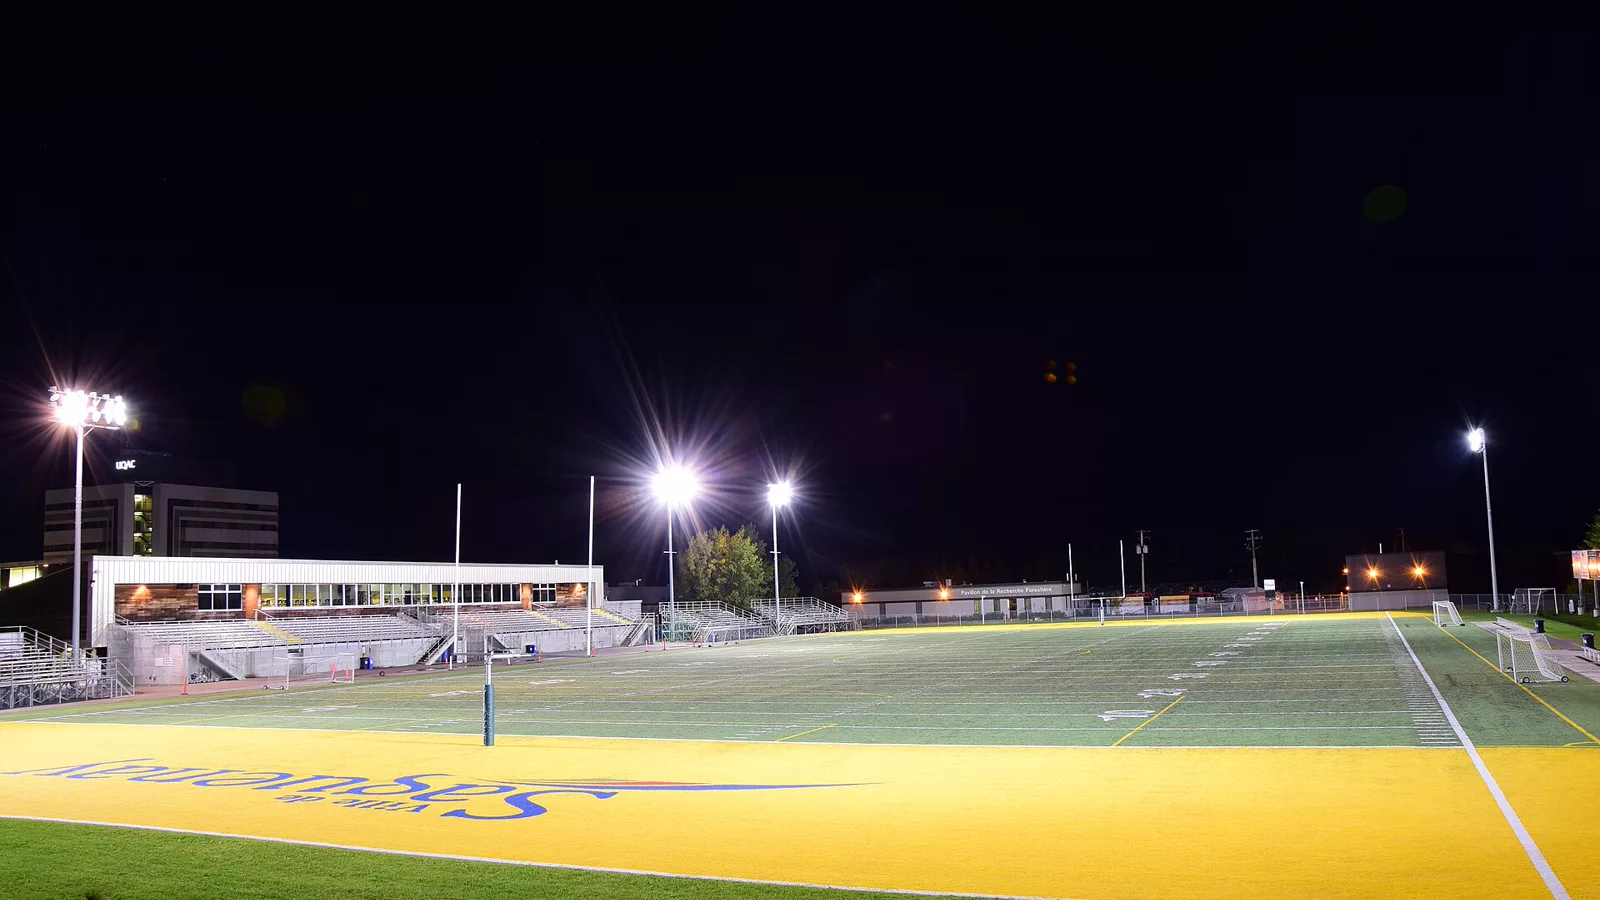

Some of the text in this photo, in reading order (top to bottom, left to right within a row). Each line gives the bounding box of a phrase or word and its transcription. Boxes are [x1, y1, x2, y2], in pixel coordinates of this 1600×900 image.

[115, 459, 136, 471] UQAC
[0, 757, 619, 821] Saguenay
[274, 794, 430, 813] Ville de
